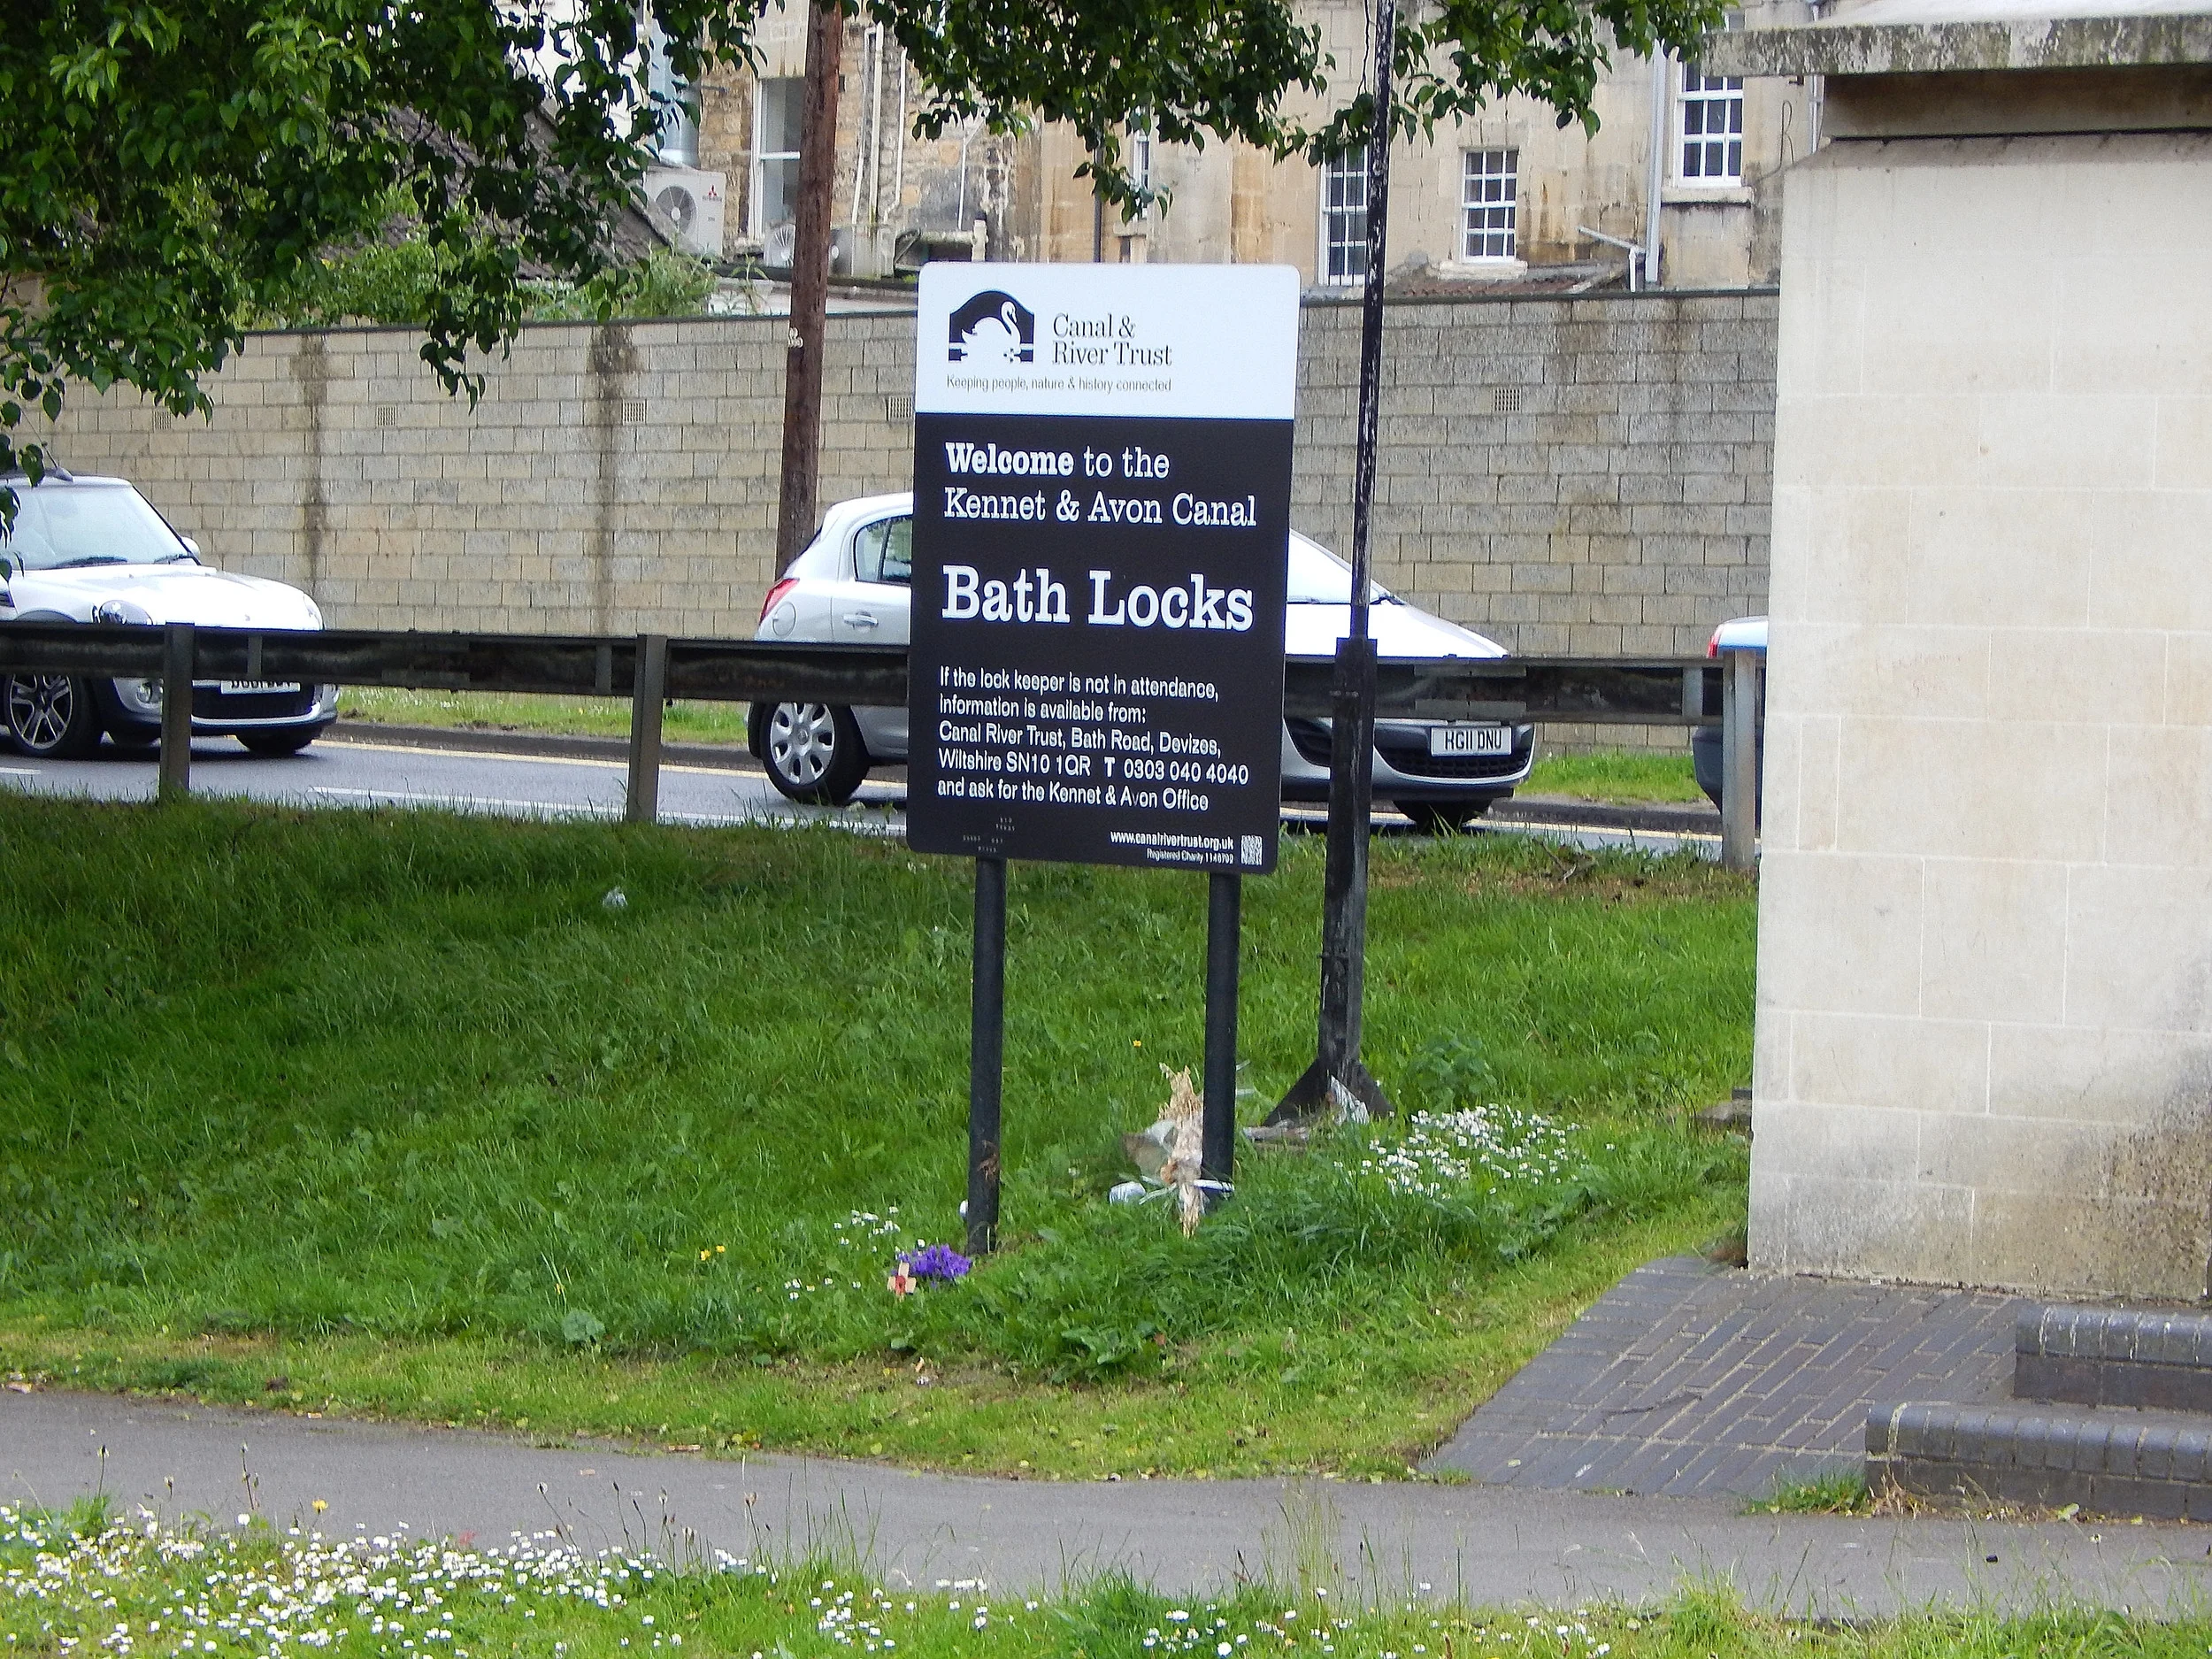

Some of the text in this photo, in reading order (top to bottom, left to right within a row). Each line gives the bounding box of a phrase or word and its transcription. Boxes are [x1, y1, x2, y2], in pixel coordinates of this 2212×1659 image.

[1053, 312, 1136, 338] Canal &
[1052, 342, 1172, 366] River Trust
[947, 374, 1171, 395] Keeping people, nature & history connected
[945, 442, 1171, 478] Welcome to the
[944, 487, 1257, 526] Kennet & Avon Canal
[941, 565, 1253, 632] Bath Locks
[940, 666, 1219, 702] If the lock keeper is not in attendance,
[940, 694, 1147, 725] information is available from:
[939, 720, 1222, 758] Canal River Trust, Bath Road, Devizes,
[1478, 731, 1502, 749] DNU
[939, 748, 1249, 785] Wiltshire SN10 1QR T 0303 040 4040
[938, 778, 1210, 810] and ask for the Kennet & Avon Office
